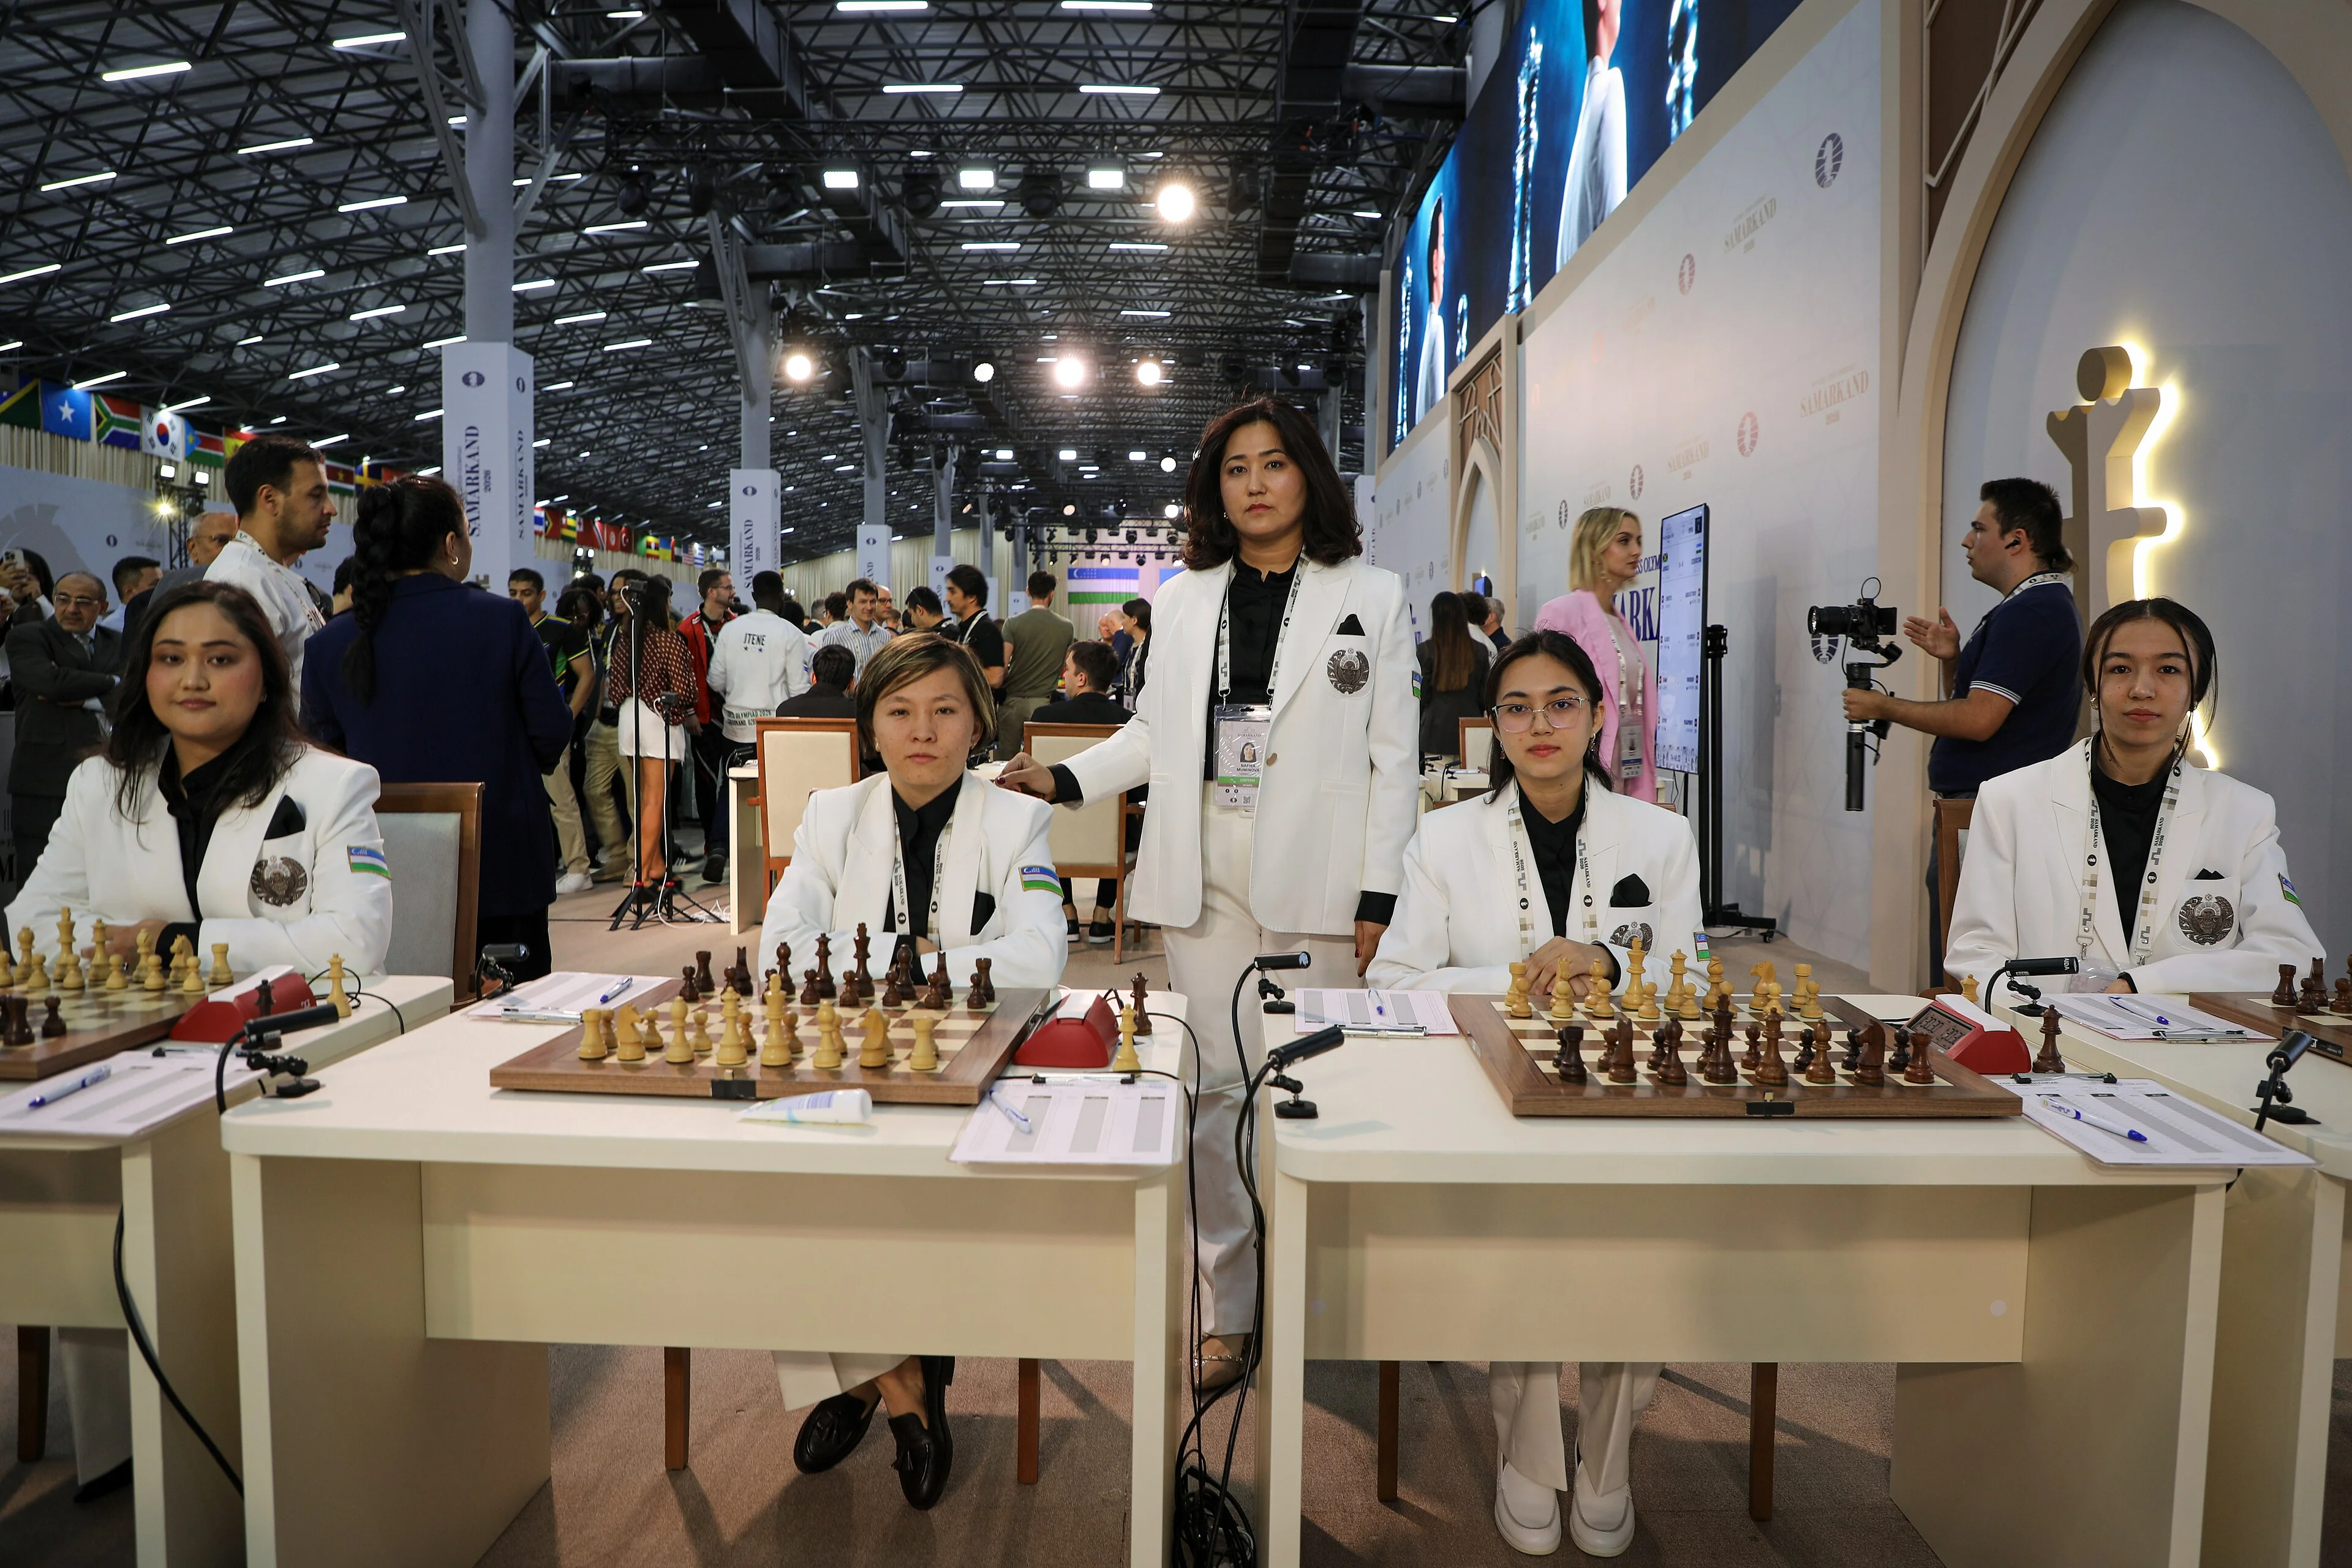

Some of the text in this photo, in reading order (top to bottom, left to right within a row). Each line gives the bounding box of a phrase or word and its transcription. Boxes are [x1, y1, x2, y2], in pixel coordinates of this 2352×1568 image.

[1724, 197, 1776, 254] SAMARKAND
[1800, 370, 1869, 418] SAMARKAND
[464, 426, 480, 537] SAMARKAND
[744, 519, 753, 589] SAMARKAND
[2154, 816, 2165, 846] SAMARKAND
